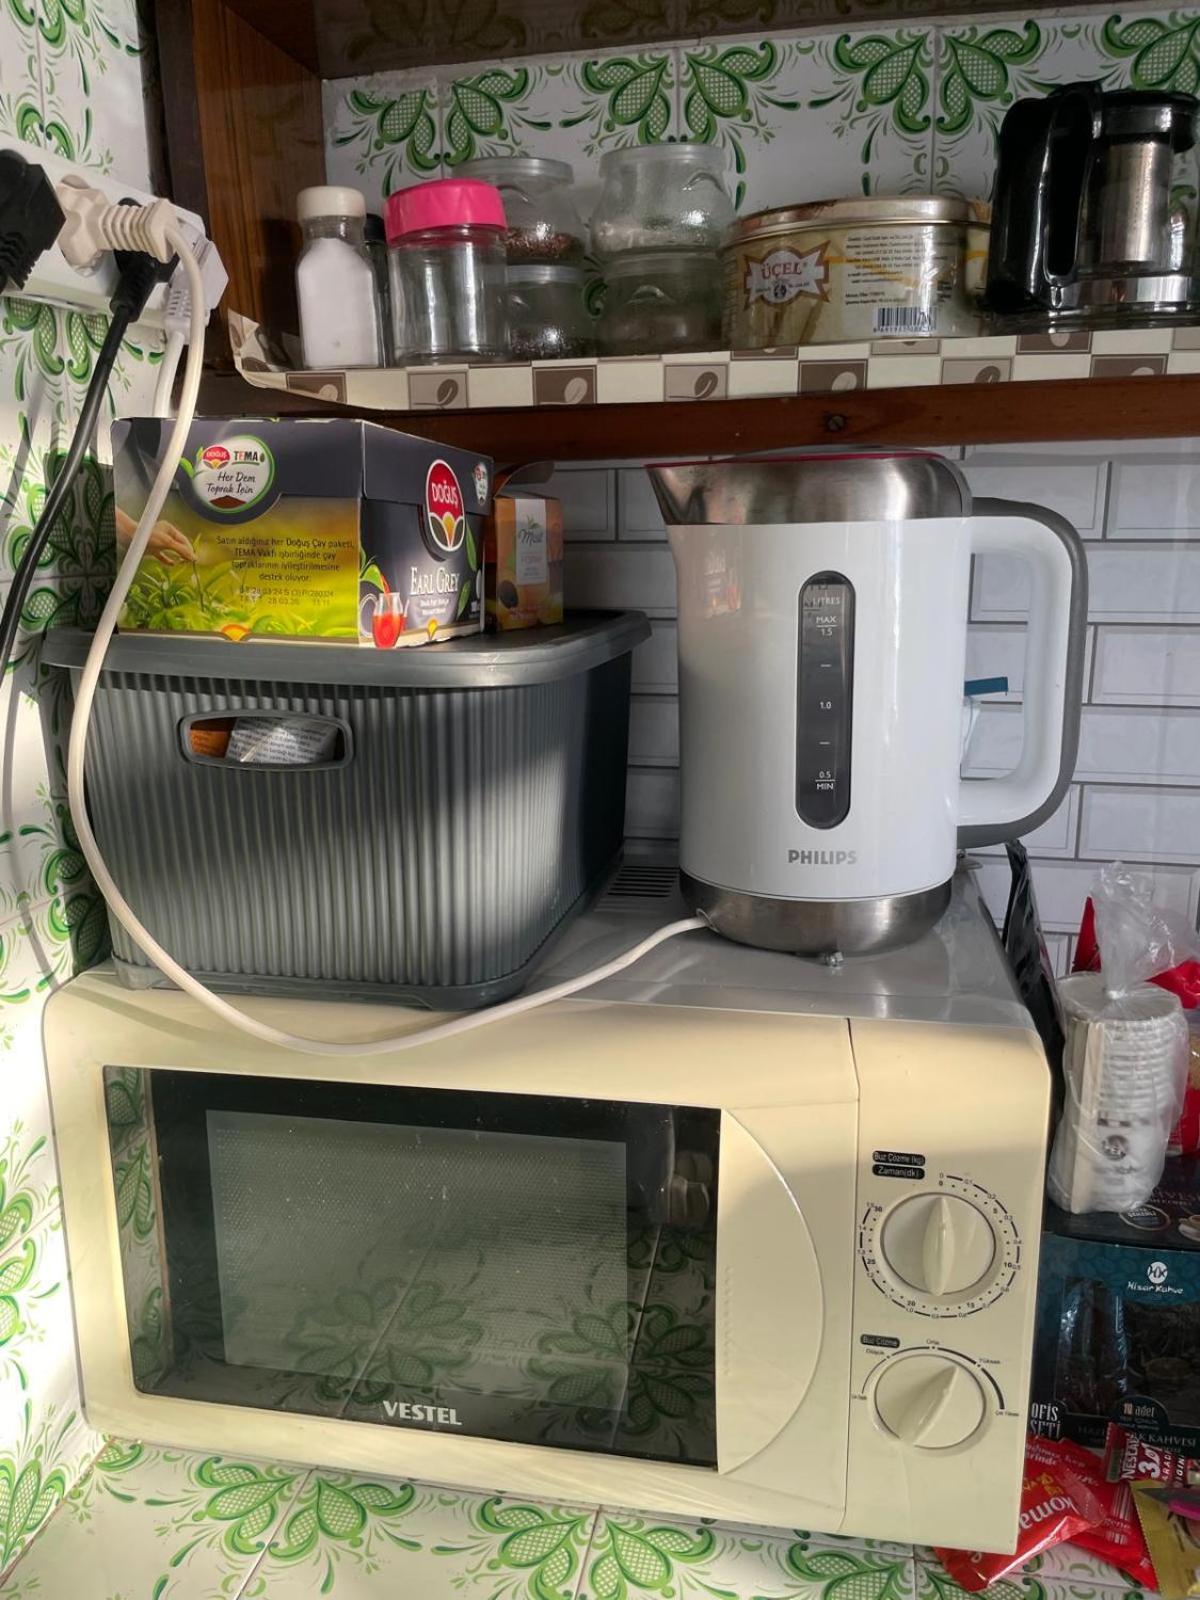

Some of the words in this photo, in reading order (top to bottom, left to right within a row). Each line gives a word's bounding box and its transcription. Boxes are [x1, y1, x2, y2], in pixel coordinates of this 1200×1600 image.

[233, 450, 258, 462] TEMA
[217, 471, 234, 482] Her
[235, 472, 256, 483] Dem
[431, 480, 459, 508] DOĞUŞ
[286, 537, 310, 549] Doğuş
[410, 566, 436, 596] EARL
[437, 567, 459, 593] GREY
[812, 596, 841, 605] LITRES
[816, 615, 837, 624] MAX
[820, 628, 833, 636] 1.5
[819, 701, 832, 709] 1.0
[818, 771, 832, 779] 0.5
[816, 782, 834, 791] MIN
[788, 850, 857, 865] PHILIPS
[382, 1400, 463, 1426] VESTEL
[1031, 1402, 1059, 1422] OFİS
